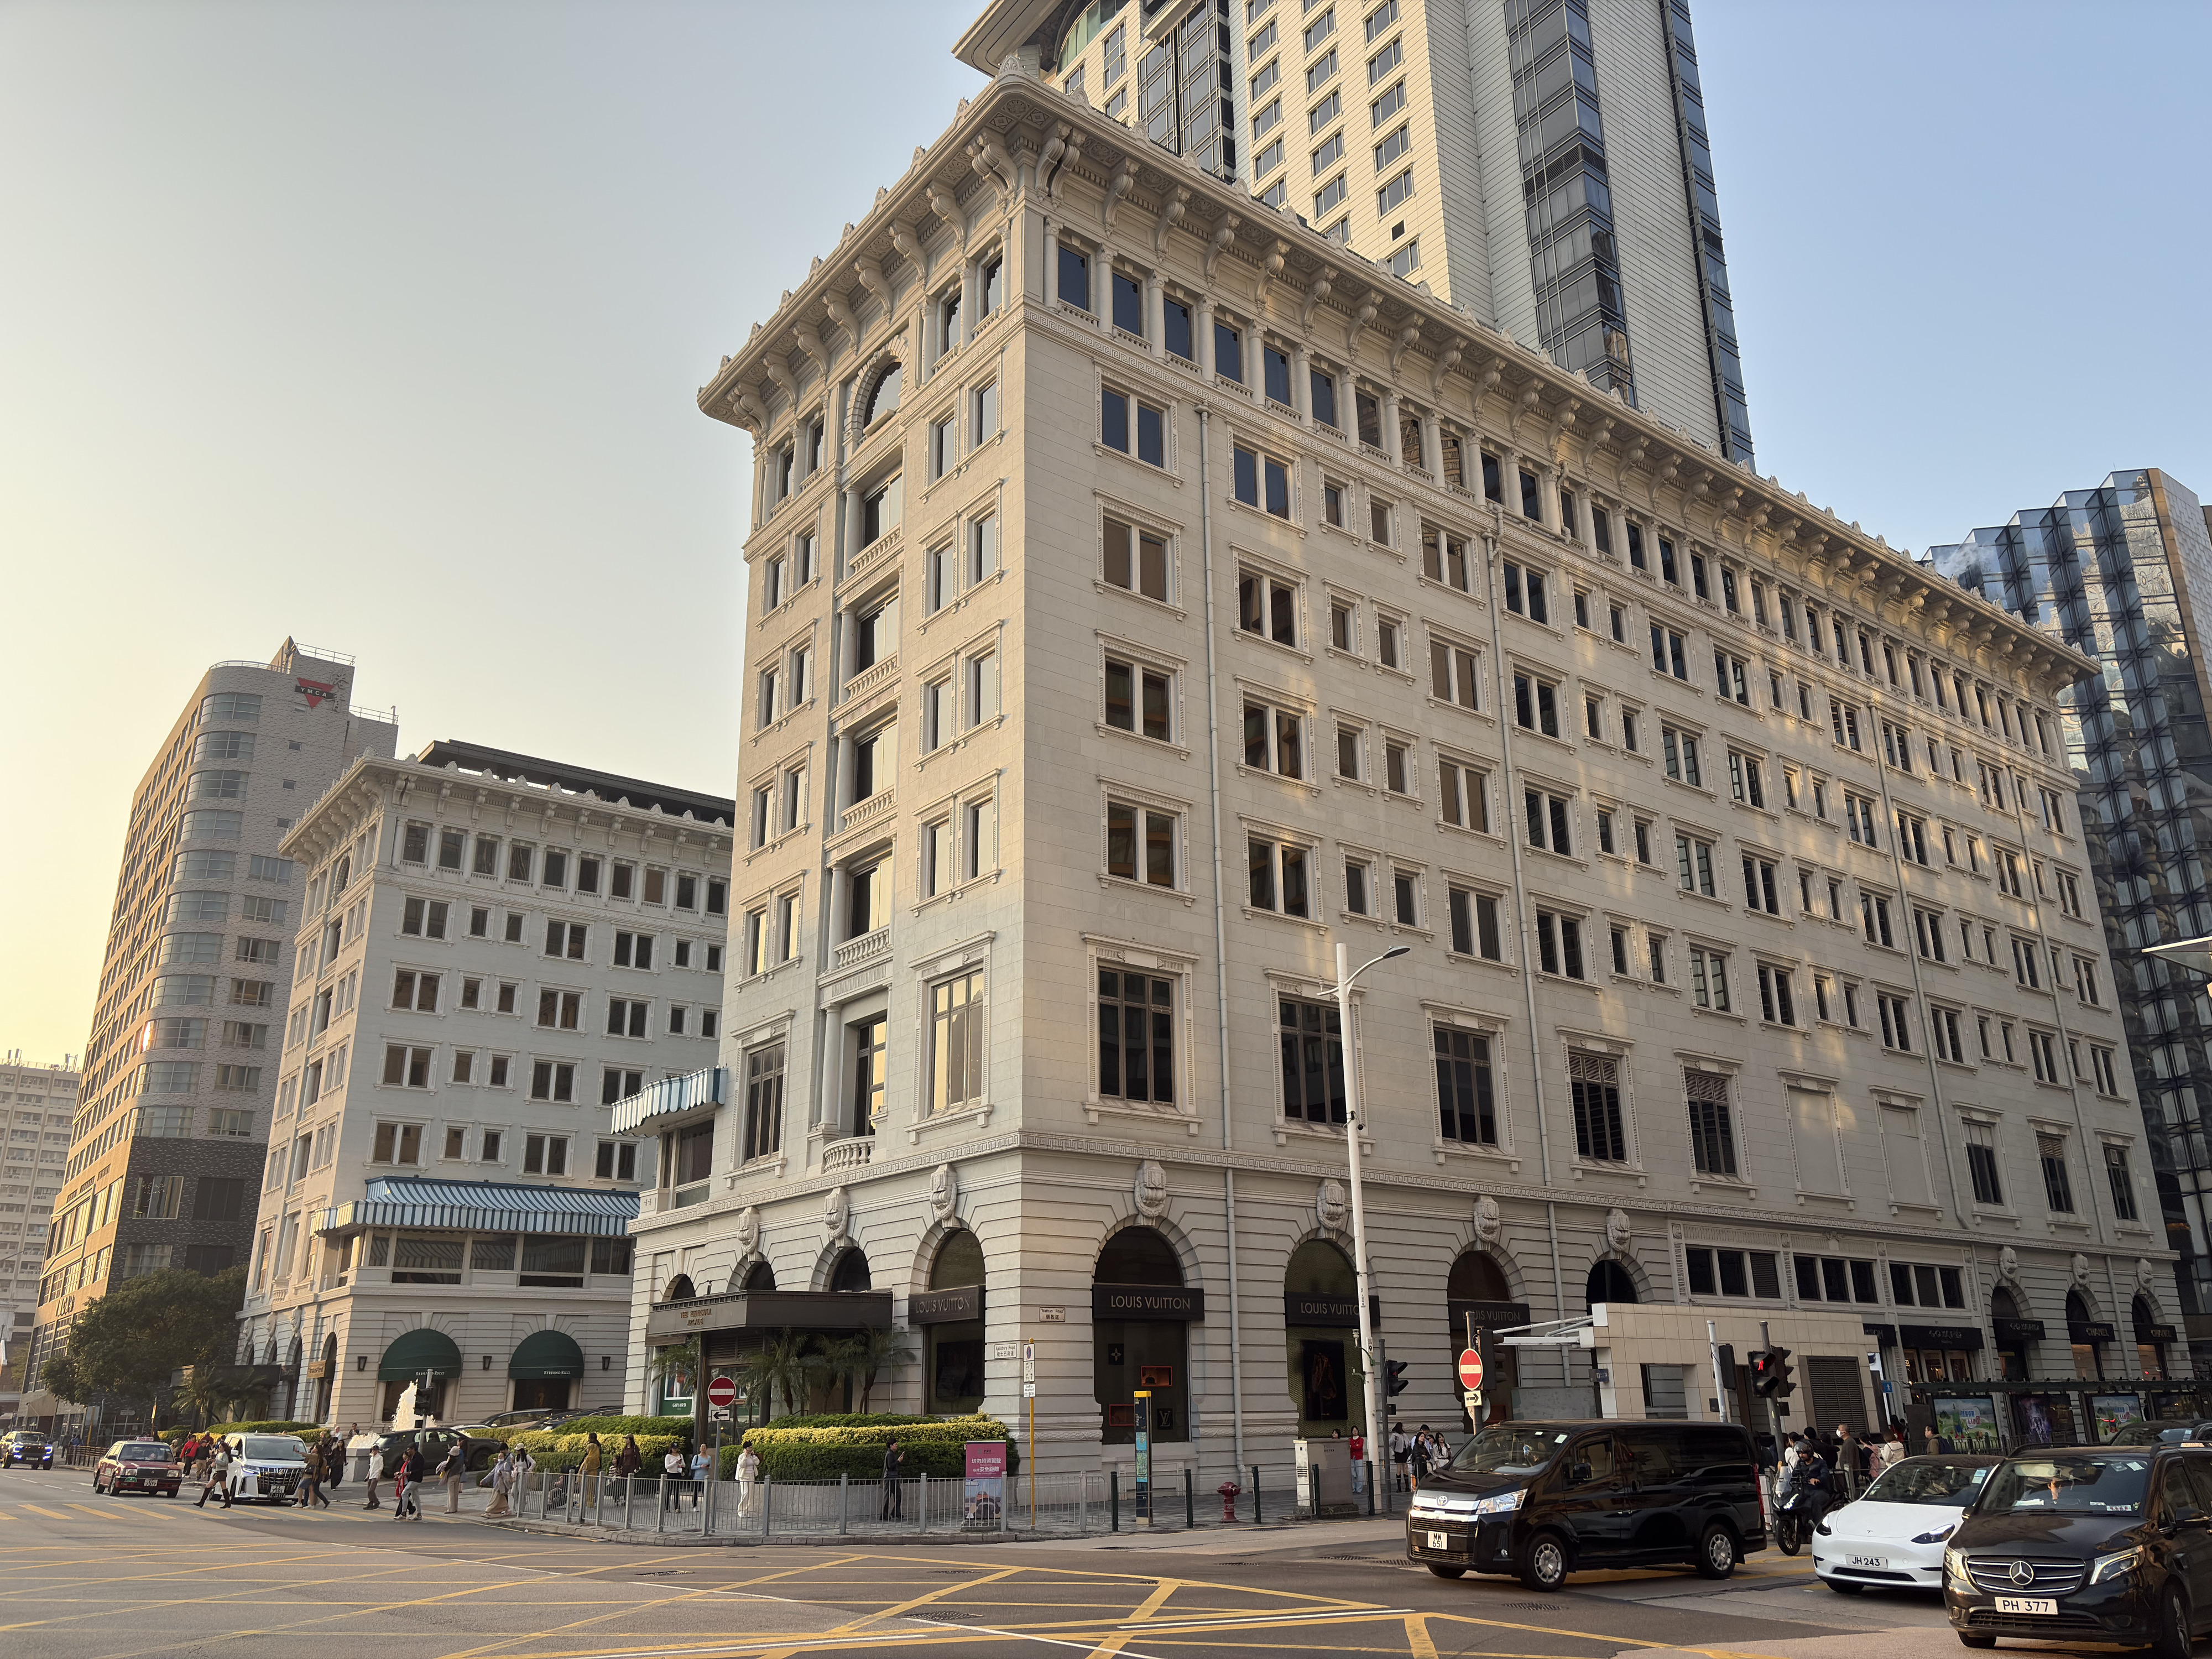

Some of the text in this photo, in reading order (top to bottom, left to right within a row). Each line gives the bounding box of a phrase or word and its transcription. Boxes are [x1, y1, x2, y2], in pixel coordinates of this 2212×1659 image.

[301, 687, 327, 697] YMCA
[916, 1296, 971, 1313] LOUIS VUITTON
[1111, 1295, 1191, 1310] LOUIS VUITTON
[690, 1308, 712, 1317] PENINSULA
[1301, 1302, 1359, 1315] LOUIS VUITTO
[1462, 1310, 1520, 1322] LUIS VUITTON
[2086, 1328, 2110, 1337] CHANEL
[1433, 1532, 1442, 1541] MW
[1852, 1556, 1880, 1566] JH 243
[2002, 1600, 2048, 1612] PH 377
